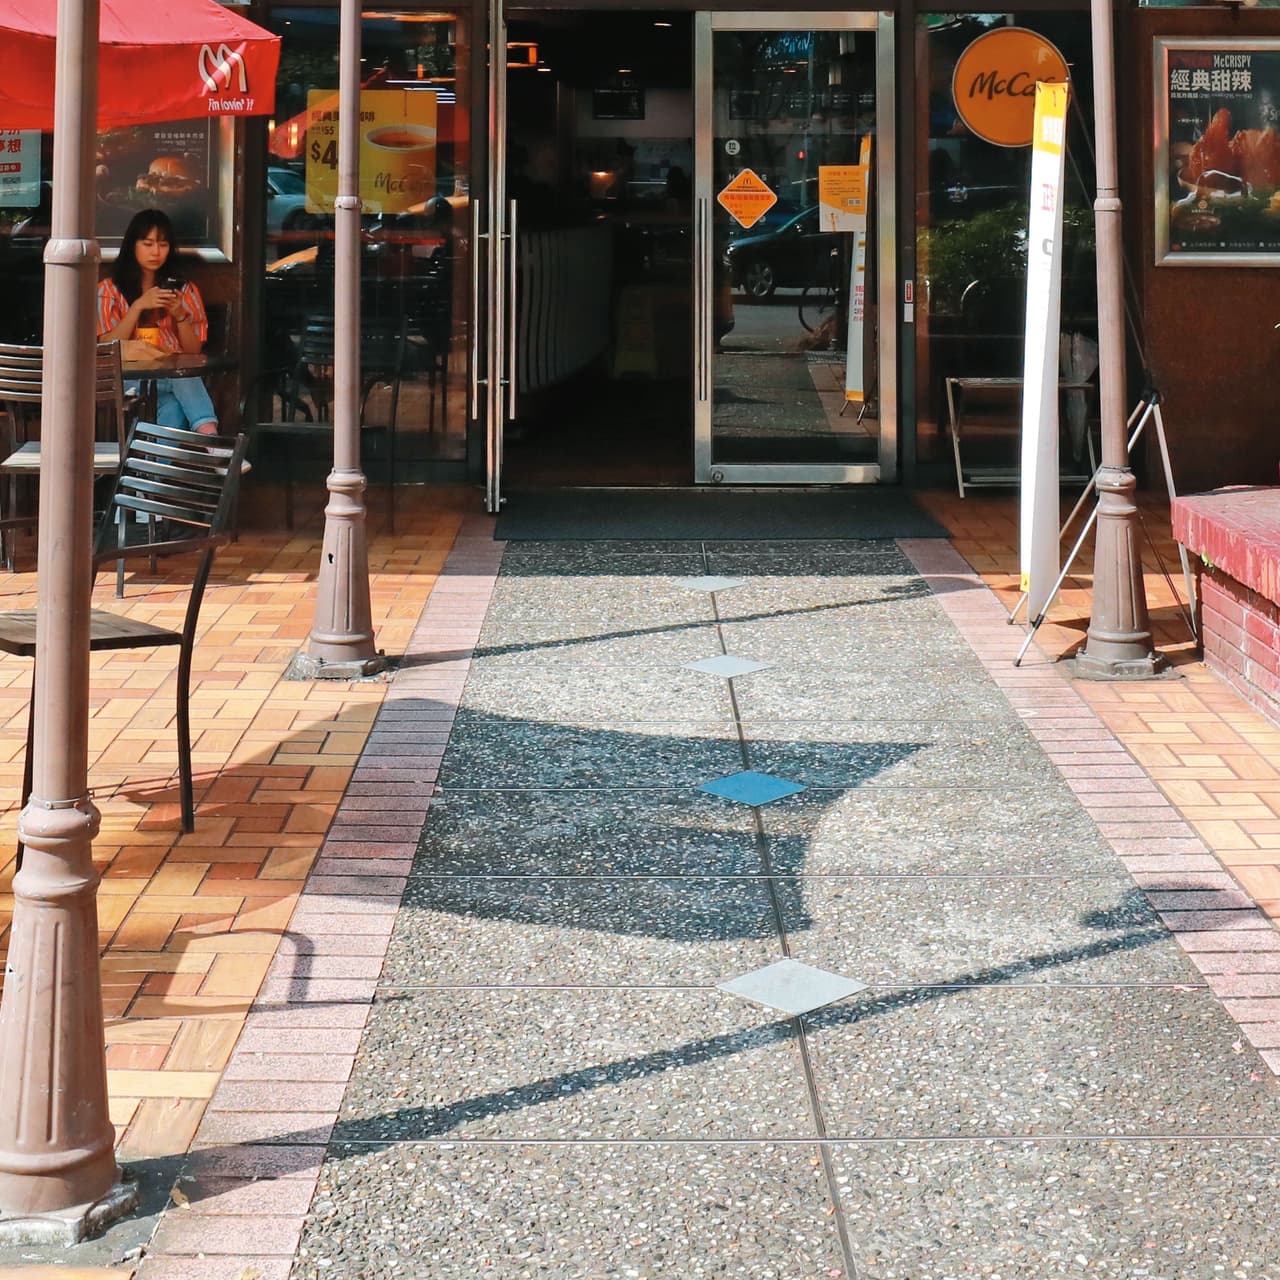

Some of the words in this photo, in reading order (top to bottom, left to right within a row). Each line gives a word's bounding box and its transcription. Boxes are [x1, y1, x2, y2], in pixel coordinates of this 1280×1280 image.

[1213, 54, 1252, 68] McCRISPY
[1170, 69, 1252, 92] 經典甜辣
